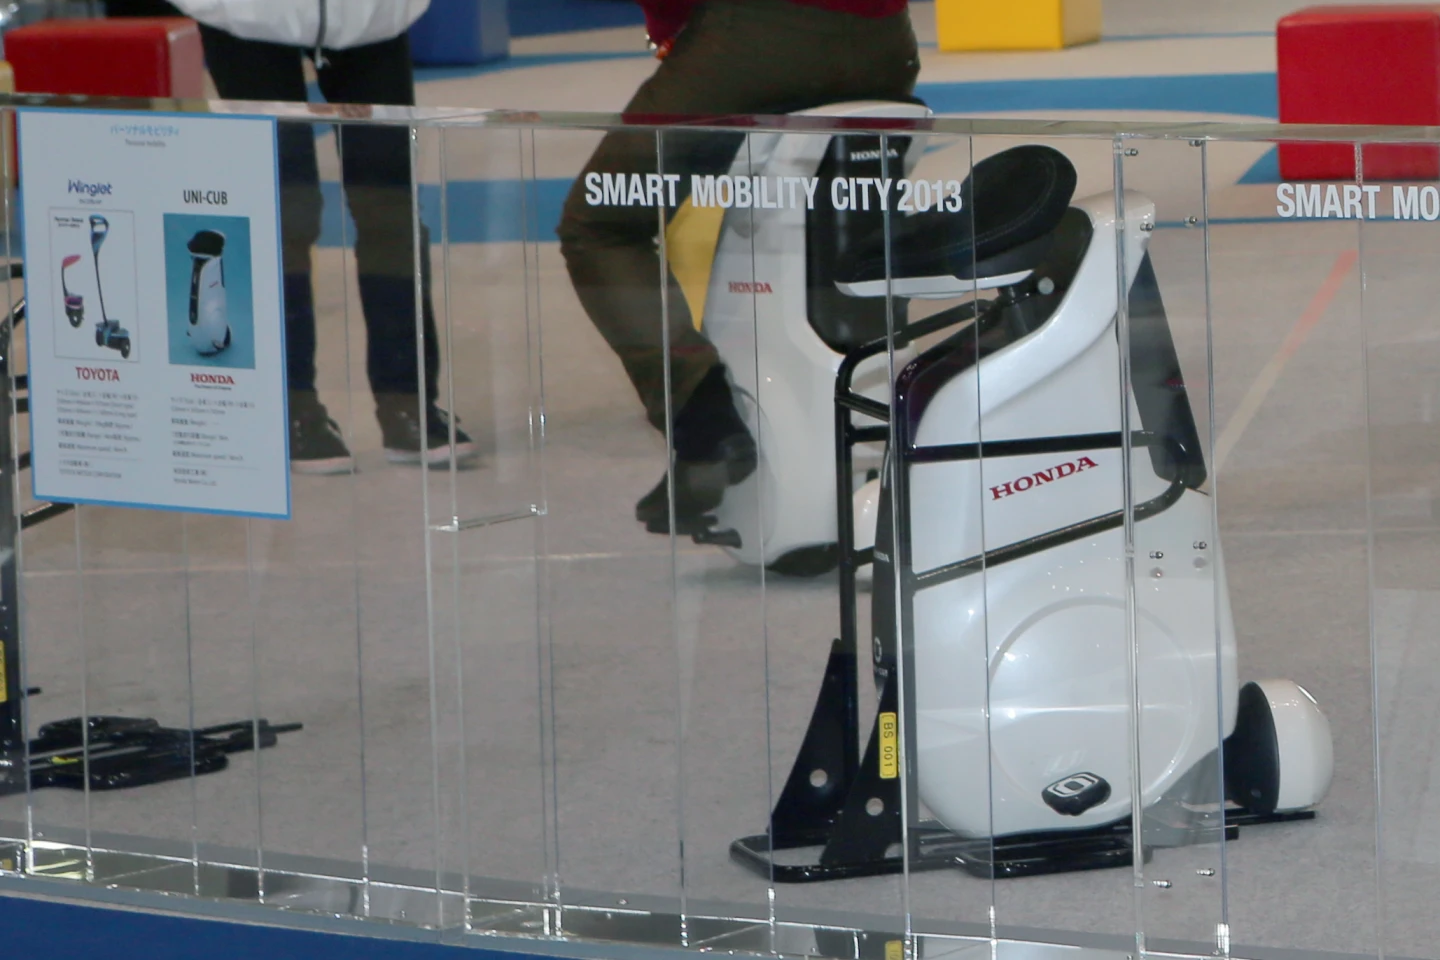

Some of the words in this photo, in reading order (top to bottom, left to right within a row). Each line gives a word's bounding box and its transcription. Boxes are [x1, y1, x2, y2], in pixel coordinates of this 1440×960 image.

[67, 179, 113, 197] Winglet
[585, 172, 680, 207] SMART
[691, 174, 819, 210] MOBILITY
[831, 176, 892, 211] CITY
[897, 178, 963, 213] 2013
[183, 189, 228, 206] UNI-CUB
[1276, 183, 1380, 219] SMART
[728, 281, 773, 293] HONDA
[75, 366, 120, 382] TOYOTA
[190, 372, 235, 385] HONDA
[989, 456, 1099, 501] HONDA
[883, 722, 893, 739] BS
[883, 746, 893, 767] 001
